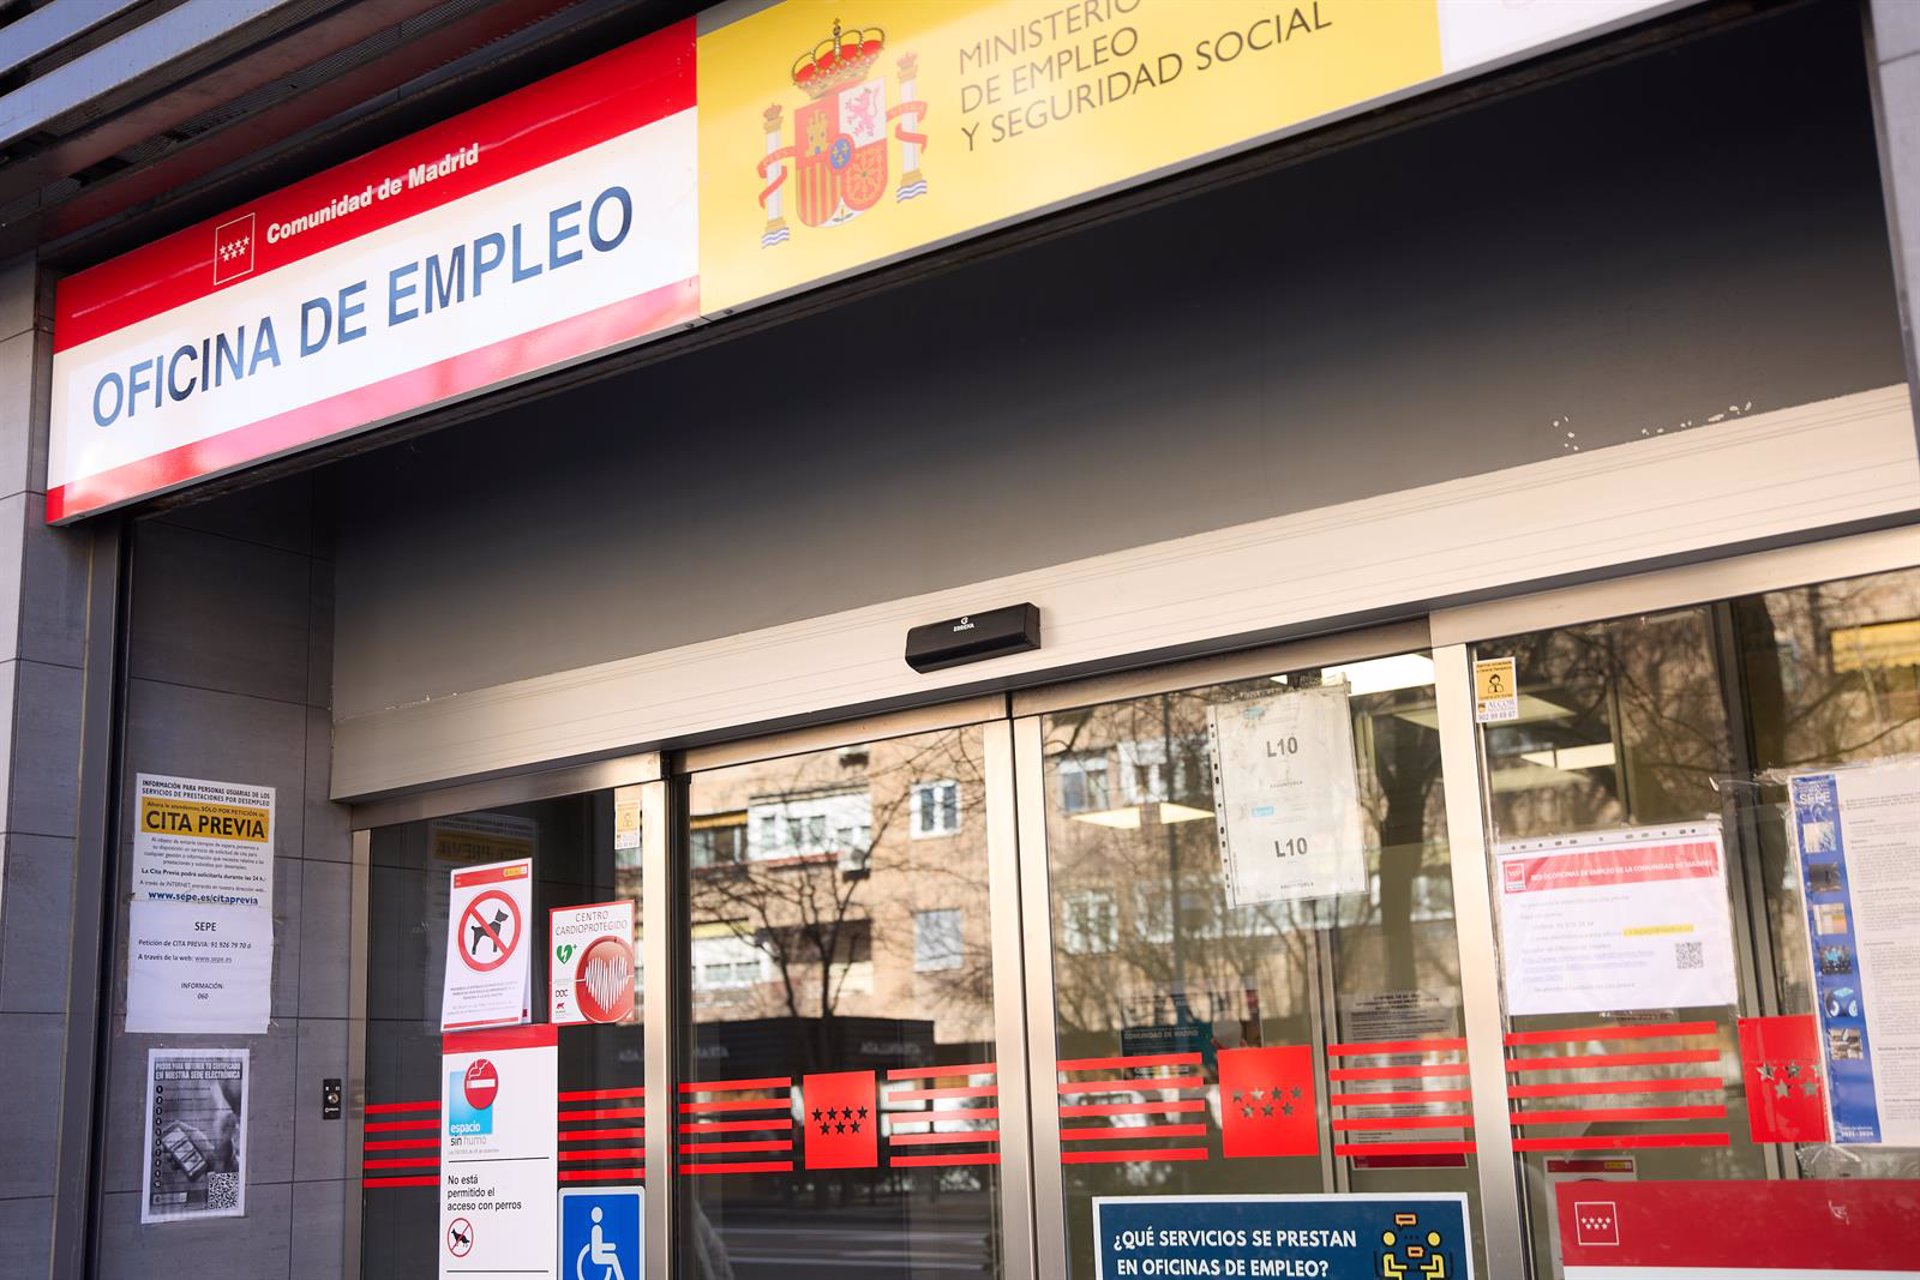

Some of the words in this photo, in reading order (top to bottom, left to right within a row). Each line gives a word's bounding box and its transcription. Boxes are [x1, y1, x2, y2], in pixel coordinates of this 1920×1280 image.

[961, 75, 1001, 114] DE
[1013, 26, 1138, 95] EMPLEO
[961, 122, 980, 152] Y
[991, 52, 1183, 143] SEGURIDAD
[1196, 1, 1332, 71] SOCIAL
[266, 186, 373, 245] Comunidad
[376, 175, 402, 200] de
[407, 143, 479, 191] Madrid
[92, 317, 281, 427] OFICINA
[300, 281, 367, 357] DE
[388, 185, 633, 327] EMPLEO
[1266, 736, 1298, 758] L10
[142, 780, 180, 789] INFORMACIÓN
[198, 786, 224, 794] PERSONAS
[142, 788, 172, 796] SERVICIOS
[183, 792, 224, 802] PRESTACIONES
[238, 798, 270, 806] DESEMPLEO
[146, 810, 192, 832] CITA
[198, 815, 264, 838] PREVIA
[1274, 837, 1308, 858] L10
[148, 892, 258, 905] www.sepe.es/citaprevia
[575, 910, 610, 923] CENTRO
[194, 921, 217, 932] SEPE
[555, 919, 628, 936] CARDIOPROTEGIDO
[181, 982, 222, 990] INFORMACIÓN
[165, 1071, 189, 1079] NUESTRA
[190, 1070, 204, 1079] SEDE
[204, 1070, 240, 1079] ELECTRÓNICA
[450, 1120, 481, 1136] espacio
[450, 1134, 462, 1146] sin
[464, 1136, 487, 1146] humo
[448, 1175, 459, 1185] No
[461, 1174, 478, 1185] está
[448, 1186, 486, 1200] permitido
[488, 1186, 495, 1196] el
[448, 1202, 476, 1211] acceso
[478, 1202, 494, 1210] con
[495, 1201, 522, 1212] perros
[1113, 1227, 1154, 1251] ¿QUÉ
[1159, 1230, 1247, 1247] SERVICIOS
[1252, 1230, 1272, 1247] SE
[1276, 1230, 1357, 1247] PRESTAN
[1117, 1259, 1138, 1275] EN
[1142, 1258, 1220, 1276] OFICINAS
[1224, 1259, 1246, 1276] DE
[1250, 1260, 1329, 1277] EMPLEO?
